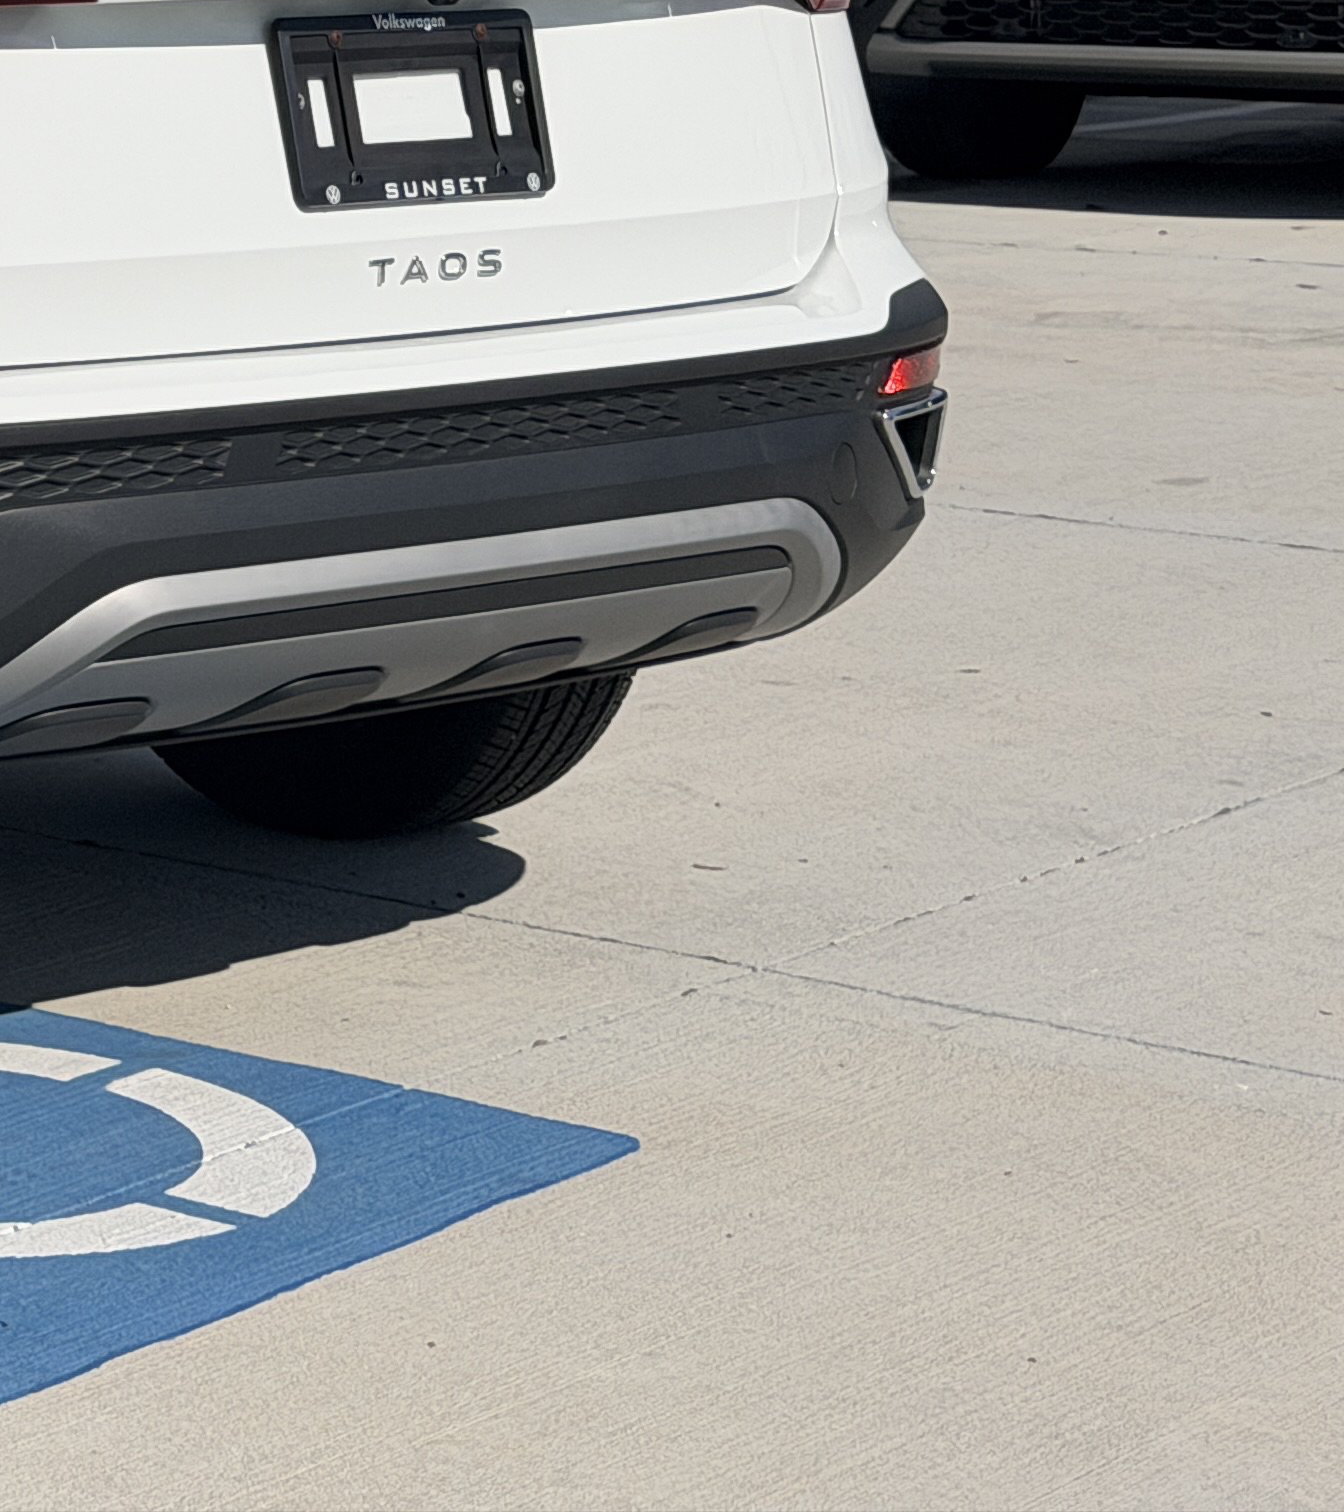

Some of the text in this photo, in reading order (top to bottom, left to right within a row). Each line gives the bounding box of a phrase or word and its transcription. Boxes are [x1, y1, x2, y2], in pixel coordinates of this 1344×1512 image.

[371, 11, 447, 32] Volkswagen
[384, 175, 488, 200] SUNSET
[367, 247, 504, 288] TAOS
